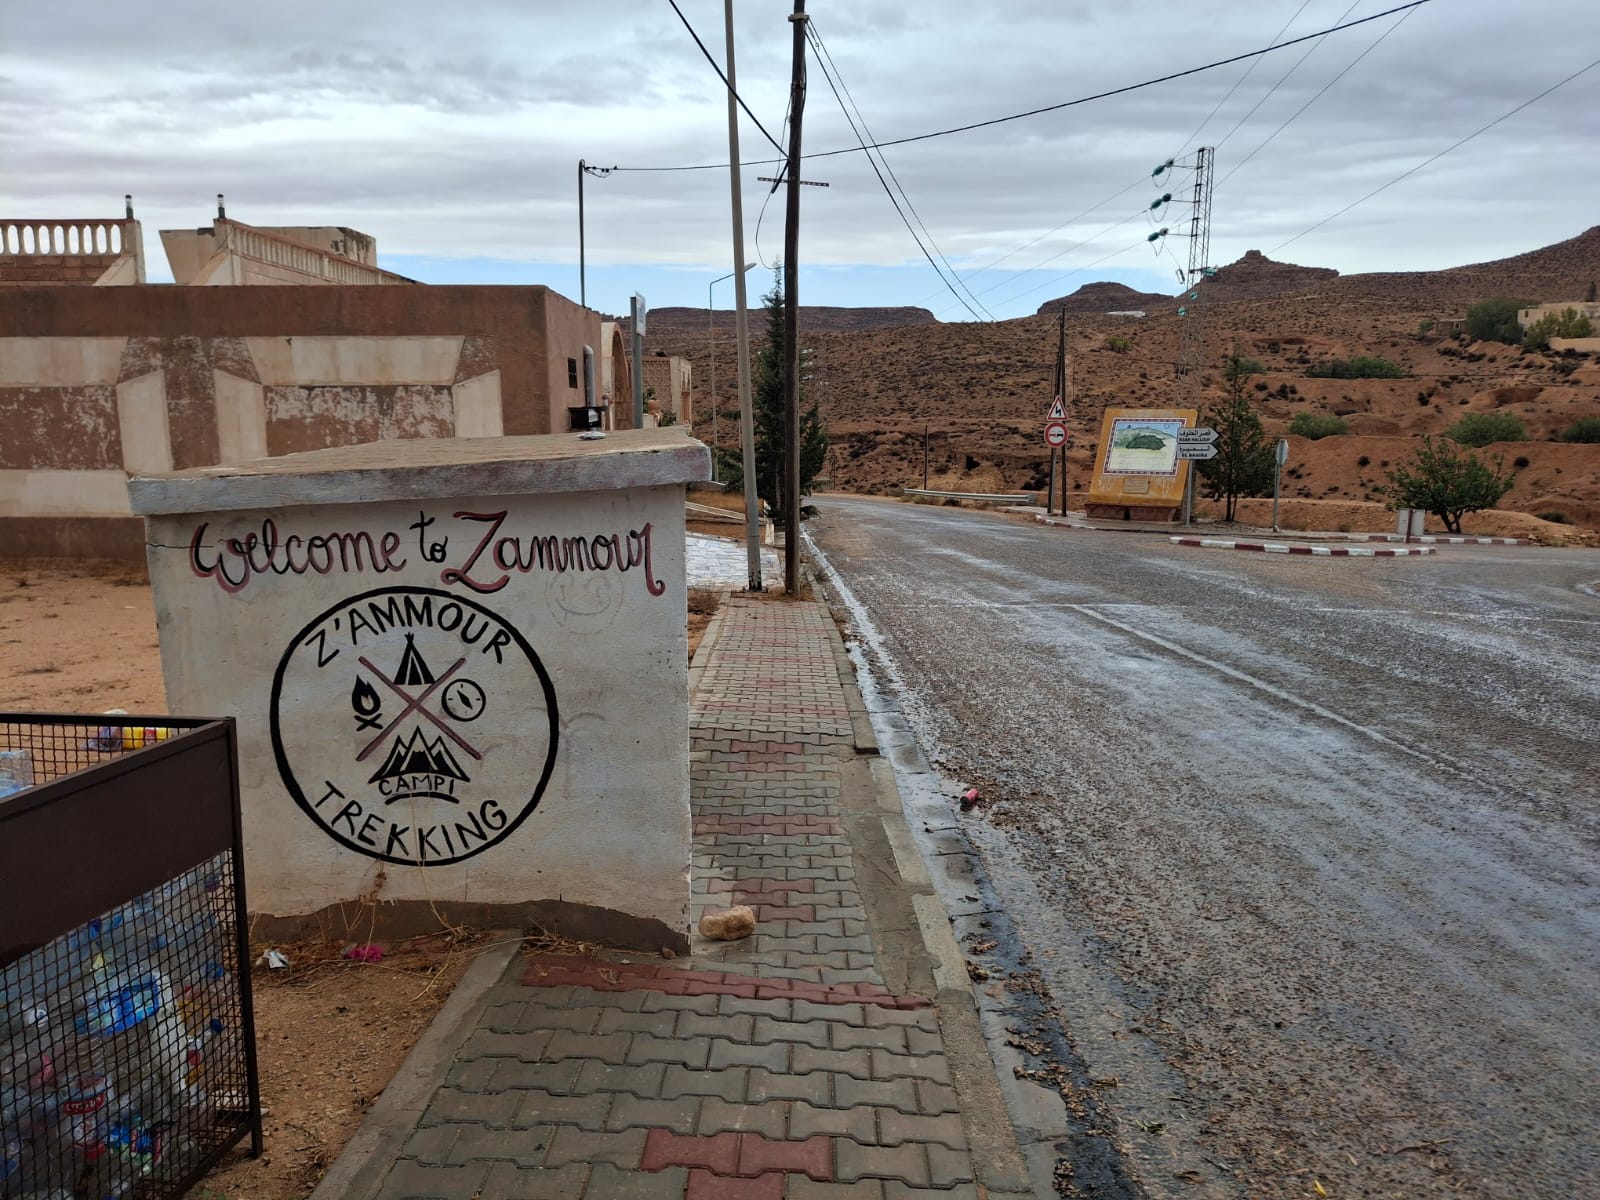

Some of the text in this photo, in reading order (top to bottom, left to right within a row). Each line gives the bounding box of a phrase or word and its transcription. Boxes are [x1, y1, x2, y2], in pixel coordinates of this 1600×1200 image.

[190, 510, 665, 596] Welcome to Zammour
[304, 596, 511, 668] Z'AMMOUR
[314, 780, 508, 859] TREKKING
